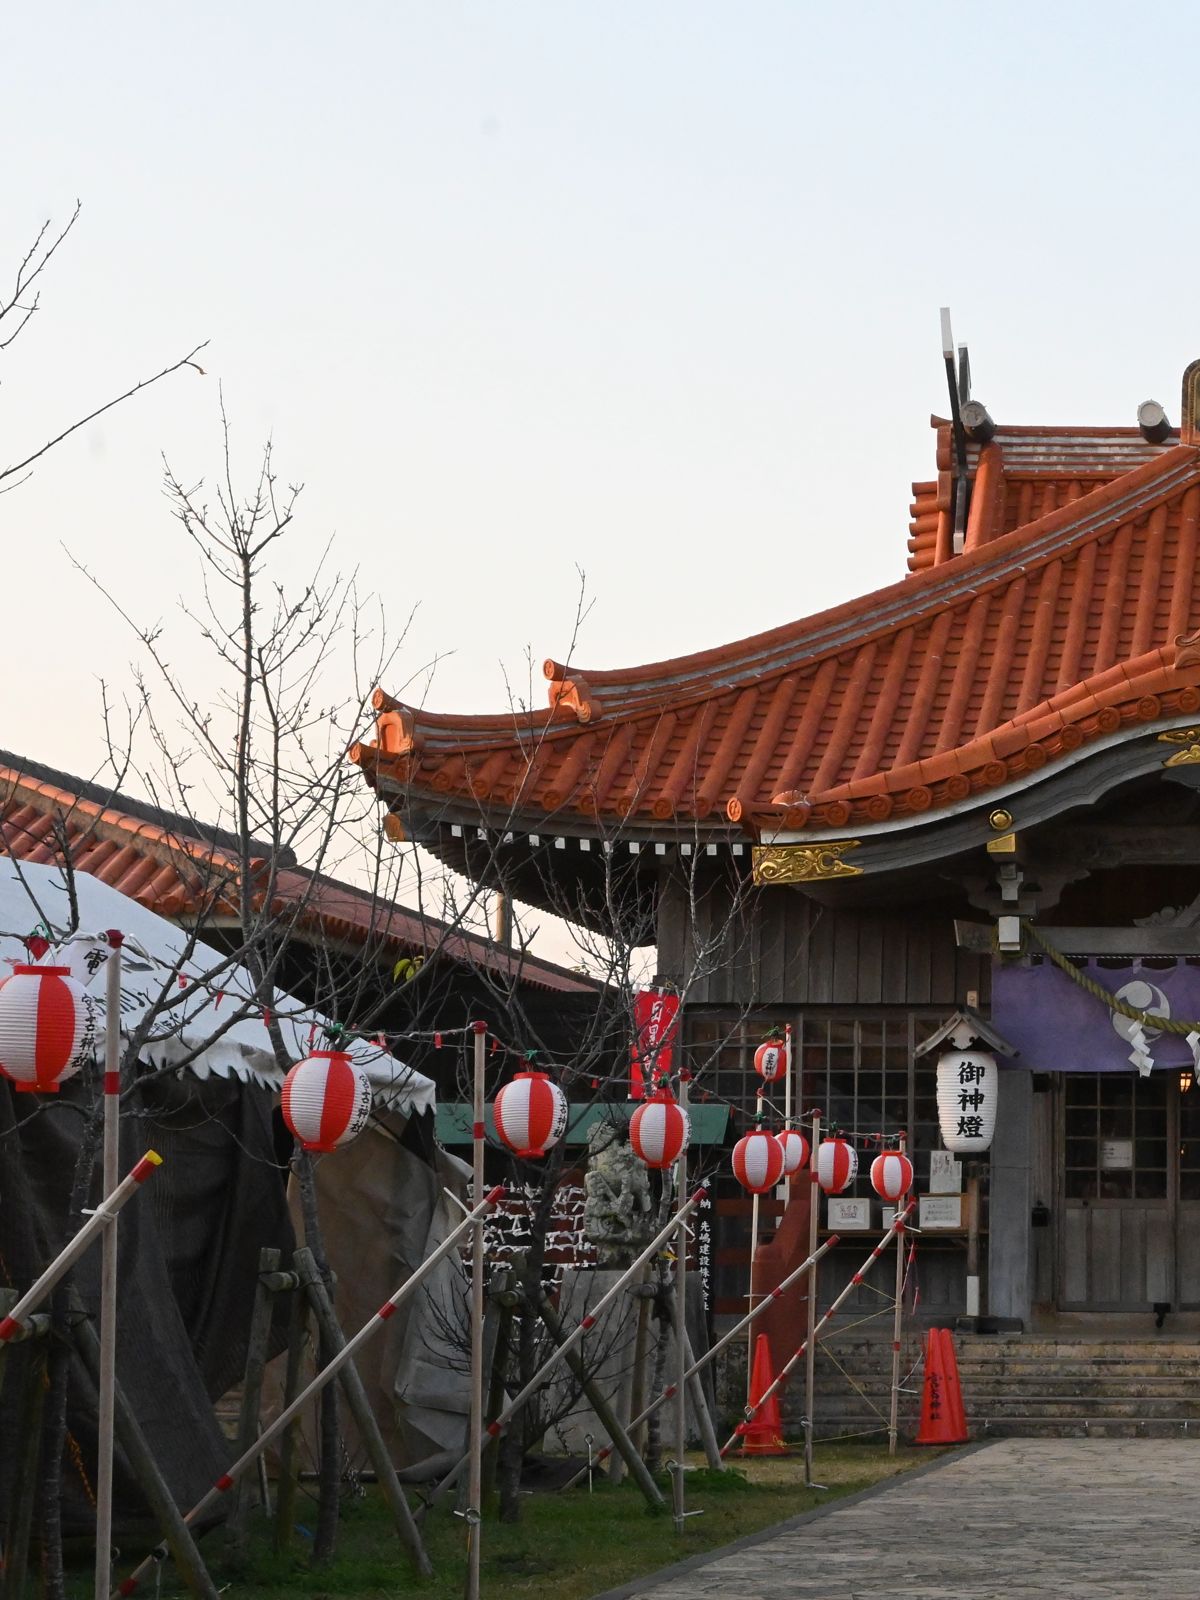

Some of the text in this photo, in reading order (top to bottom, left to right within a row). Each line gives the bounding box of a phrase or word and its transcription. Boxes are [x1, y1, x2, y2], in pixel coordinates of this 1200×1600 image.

[71, 993, 97, 1068] 宮古神社
[955, 1060, 986, 1139] 御神燈
